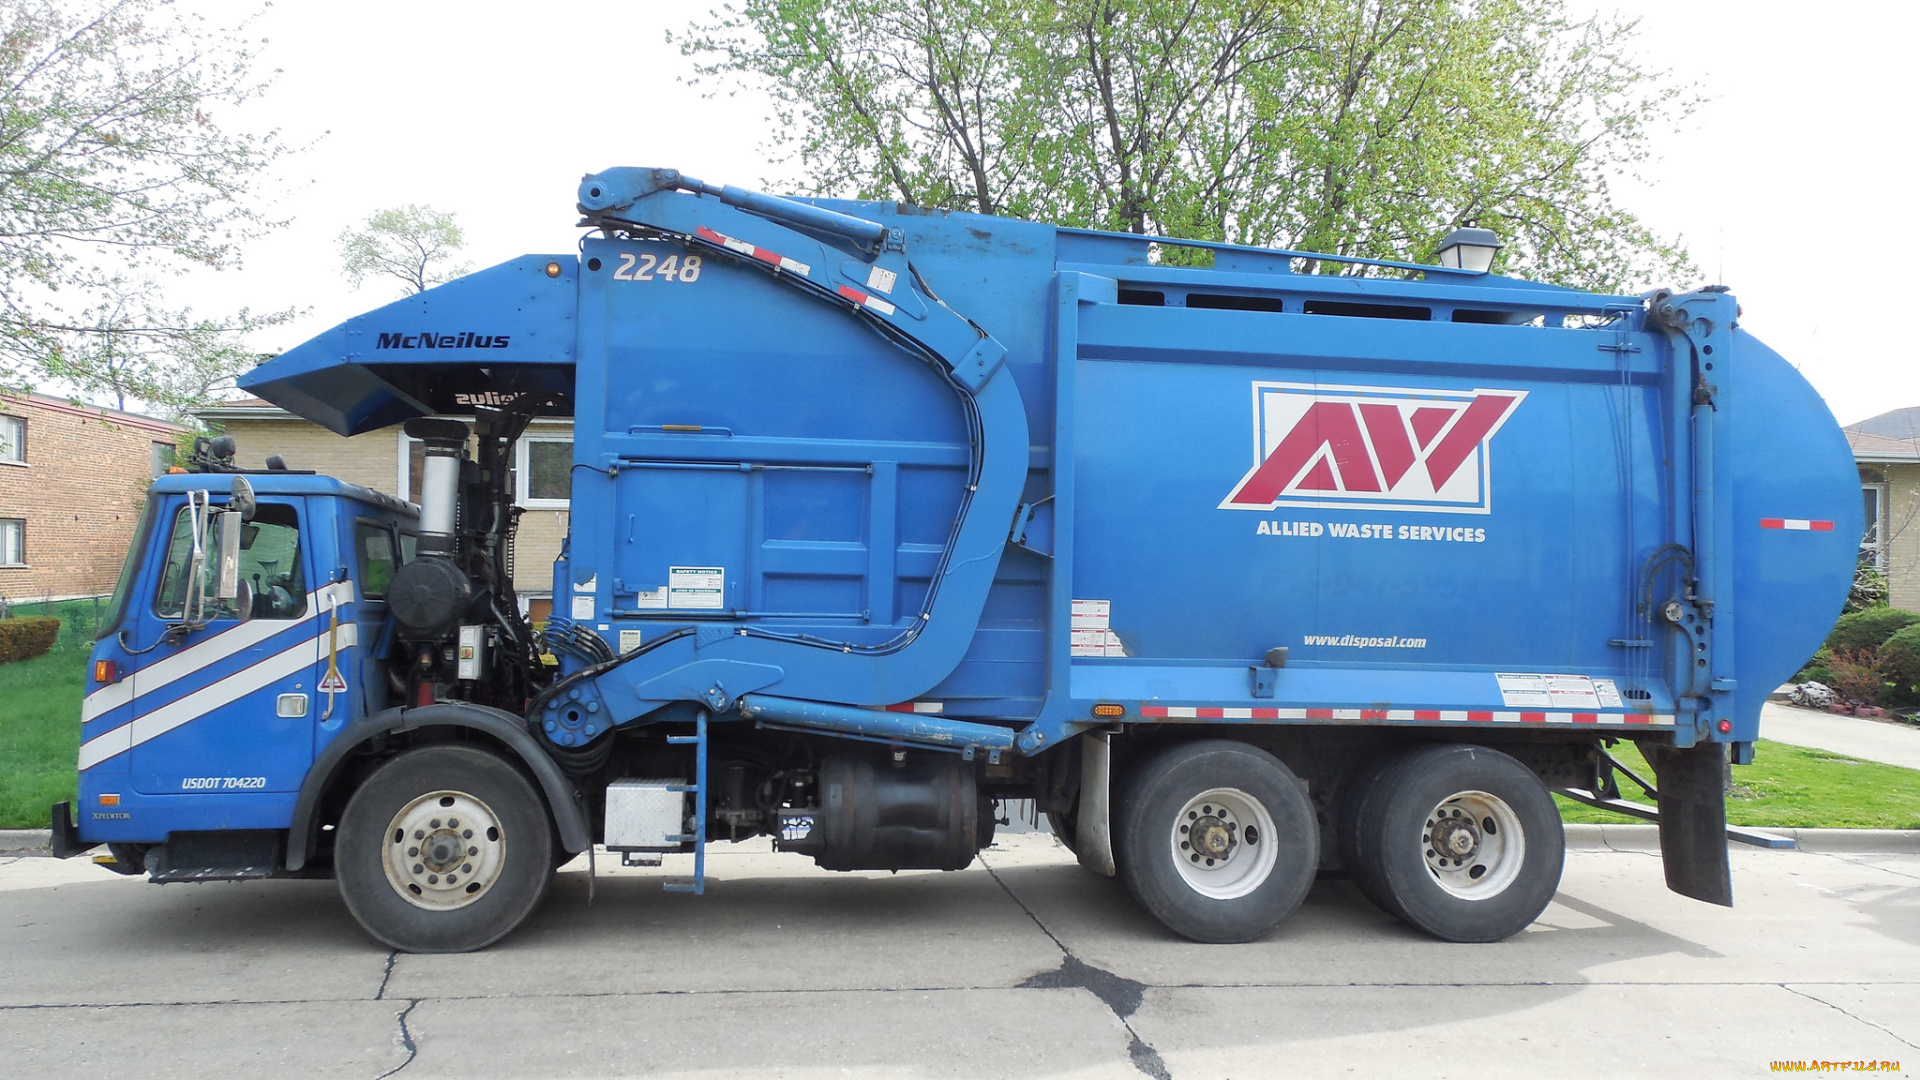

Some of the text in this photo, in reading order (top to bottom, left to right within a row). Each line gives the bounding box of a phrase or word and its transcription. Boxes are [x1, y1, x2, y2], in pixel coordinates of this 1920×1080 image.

[613, 253, 702, 283] 2248
[376, 332, 511, 350] McNeilus
[1256, 520, 1486, 543] ALLIED WASTE SERVICES
[1304, 633, 1427, 649] www.disposal.com
[182, 777, 266, 789] USDOT 704220
